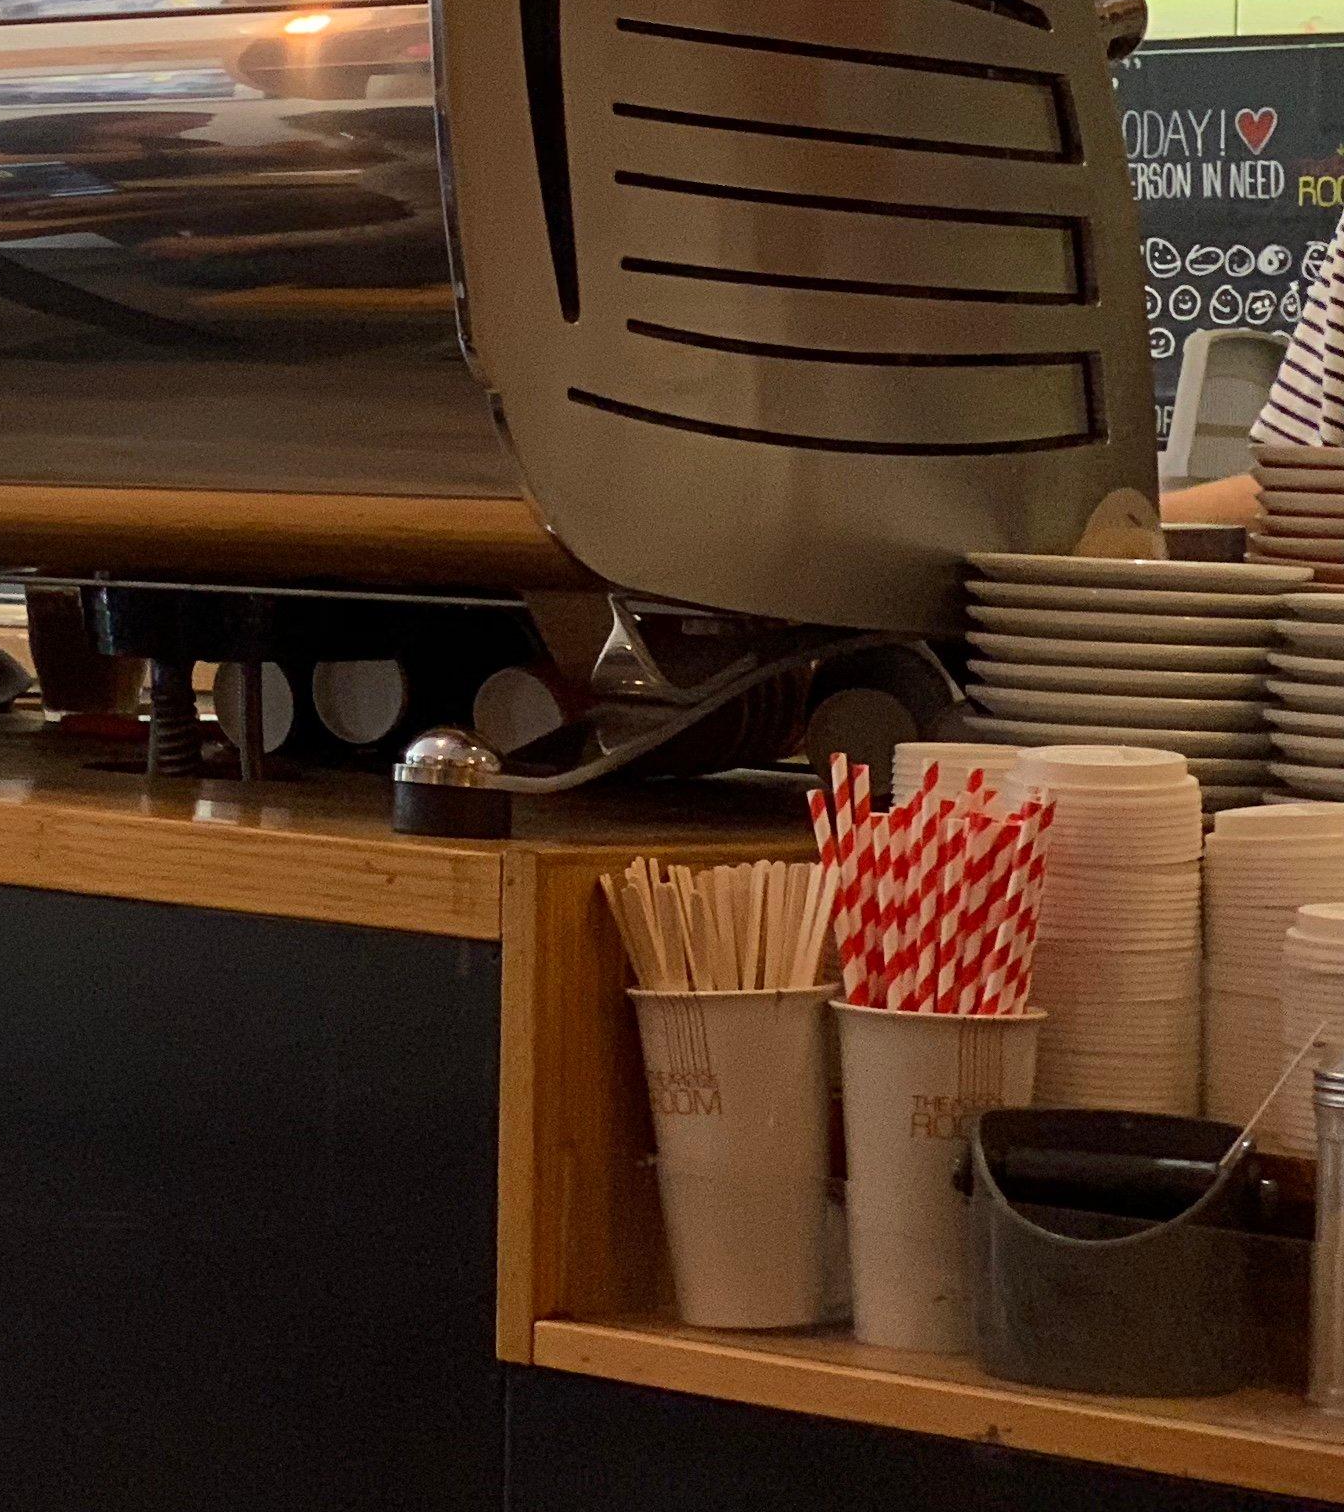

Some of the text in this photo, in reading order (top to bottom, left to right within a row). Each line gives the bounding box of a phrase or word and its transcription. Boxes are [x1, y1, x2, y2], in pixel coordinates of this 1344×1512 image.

[1122, 109, 1226, 157] ODAY!
[1202, 160, 1285, 200] IN NEED
